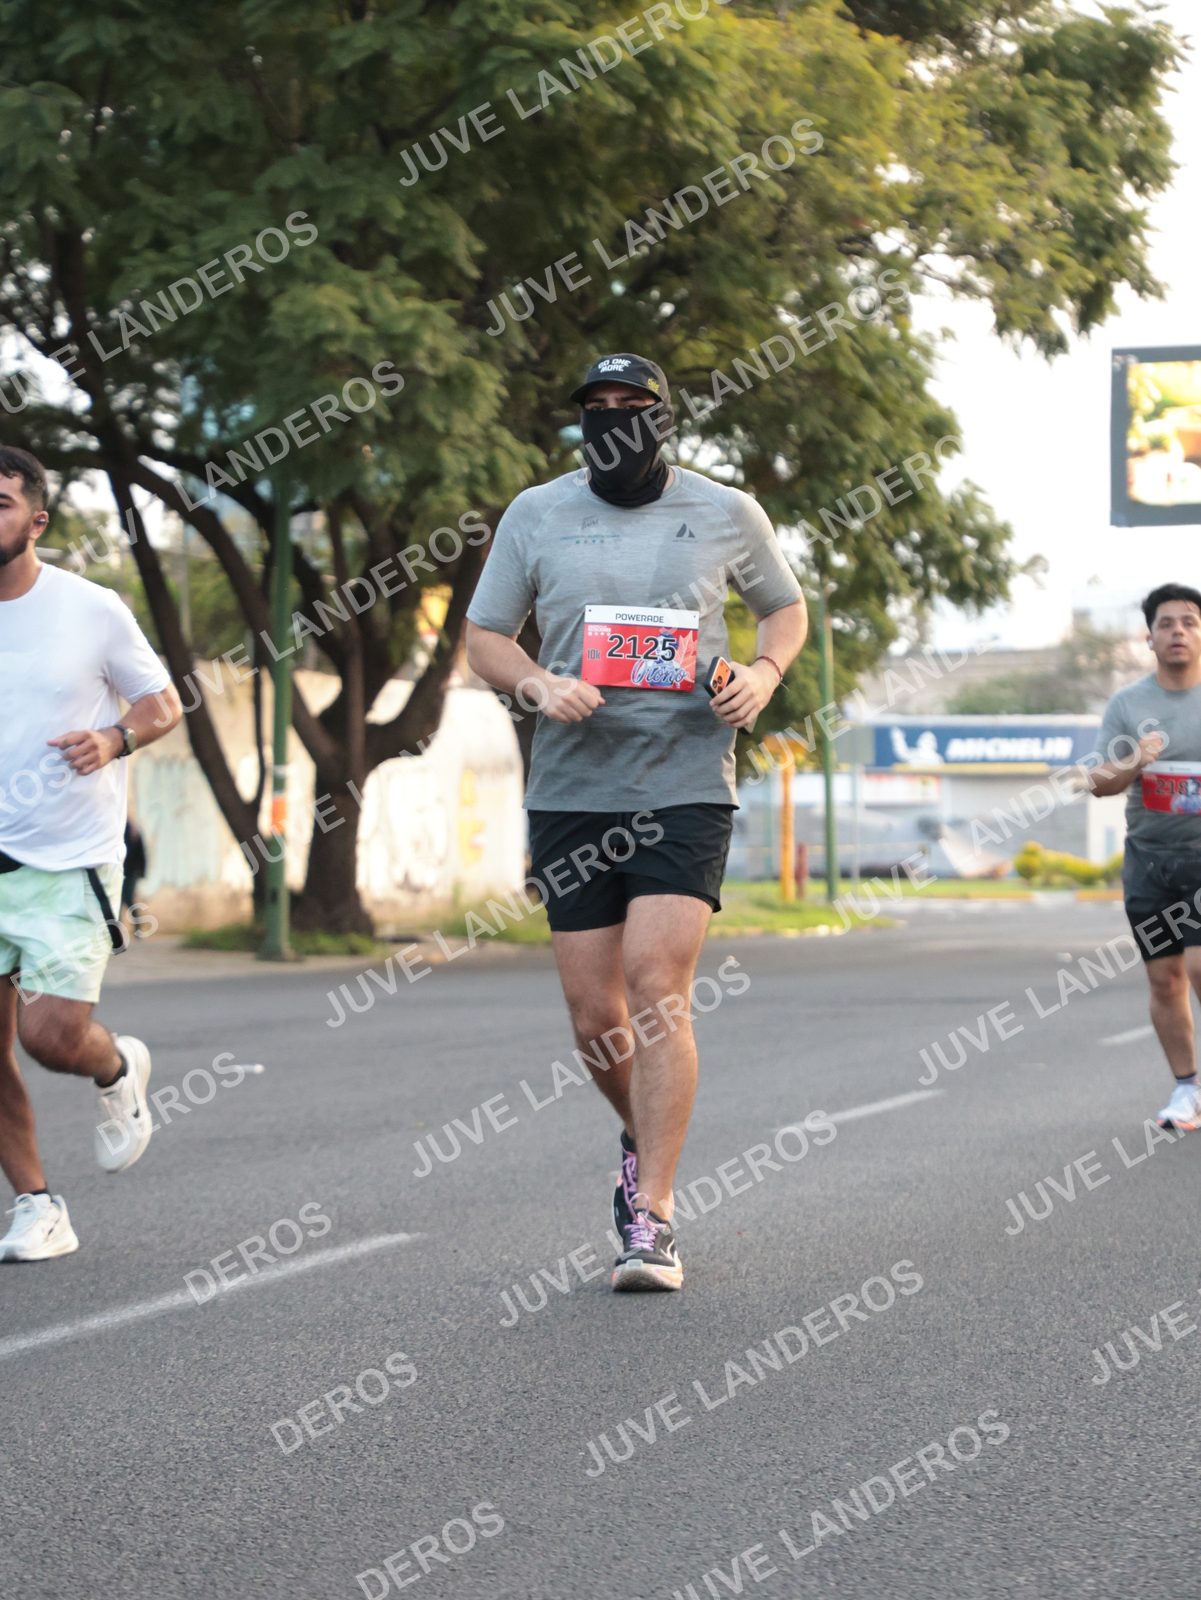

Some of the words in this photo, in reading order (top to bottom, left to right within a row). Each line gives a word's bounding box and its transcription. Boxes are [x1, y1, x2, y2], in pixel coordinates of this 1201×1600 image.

[612, 358, 631, 368] ONE
[600, 364, 624, 373] MORE
[615, 613, 665, 624] POWERADE
[607, 634, 676, 662] 2125
